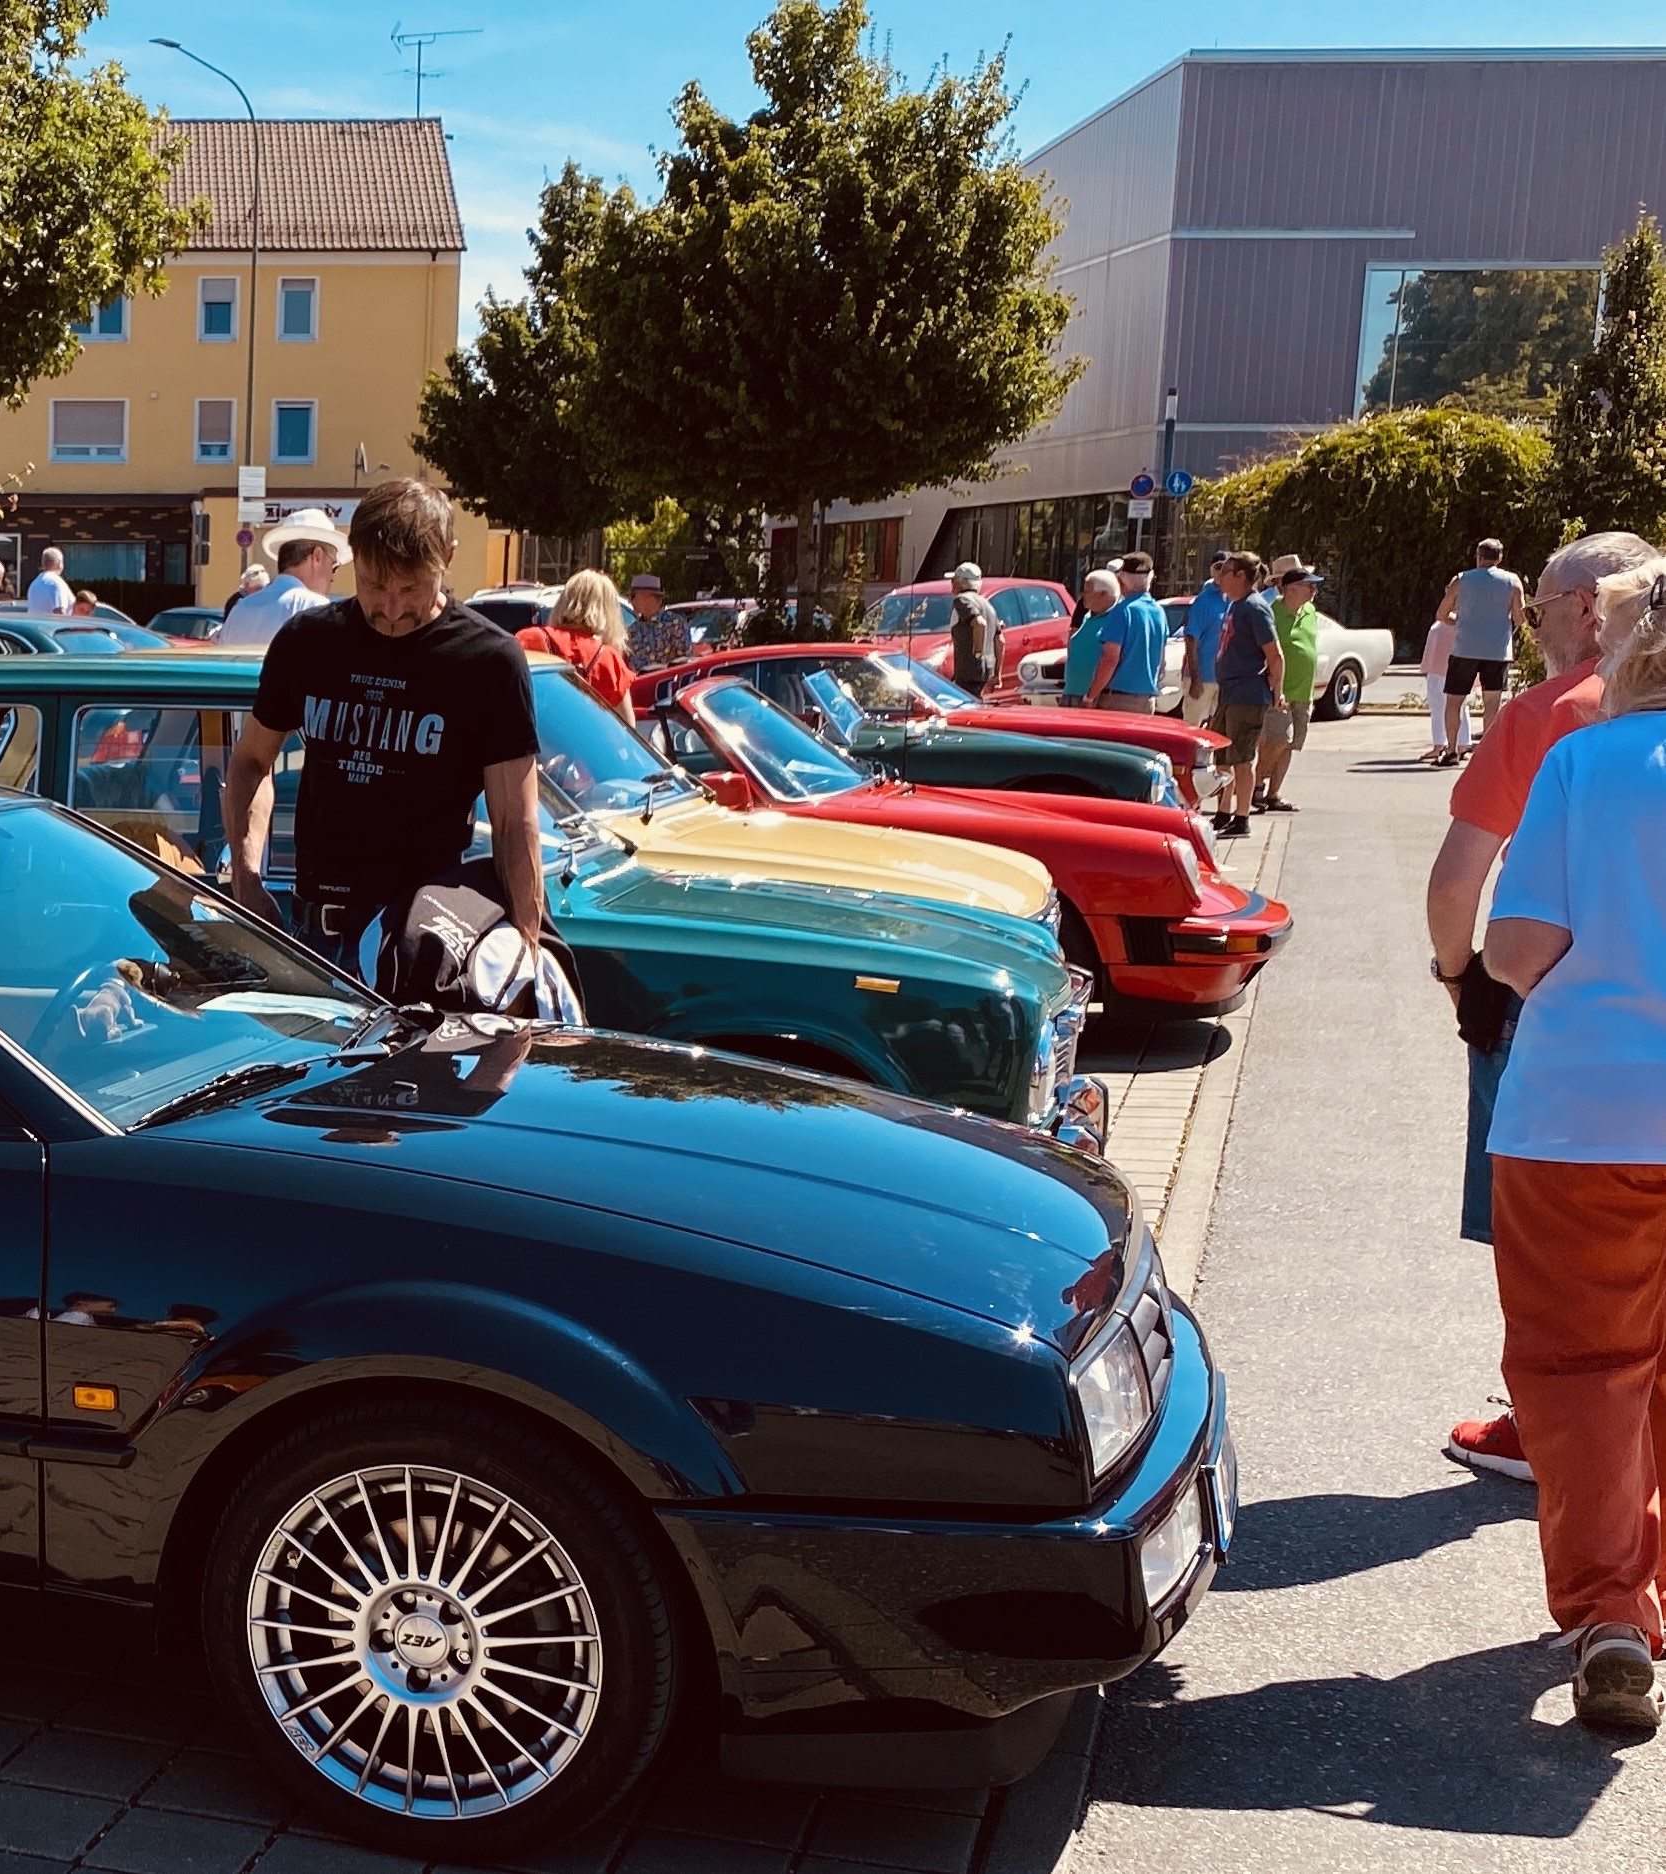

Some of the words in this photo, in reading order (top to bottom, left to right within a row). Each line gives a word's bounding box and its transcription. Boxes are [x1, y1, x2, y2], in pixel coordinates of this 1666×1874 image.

[350, 673, 374, 685] TRUE
[375, 677, 407, 690] DENIM
[304, 694, 445, 755] MUSTANG
[337, 759, 384, 776] TRADE
[347, 772, 371, 785] MARK
[399, 1633, 443, 1649] AEZ
